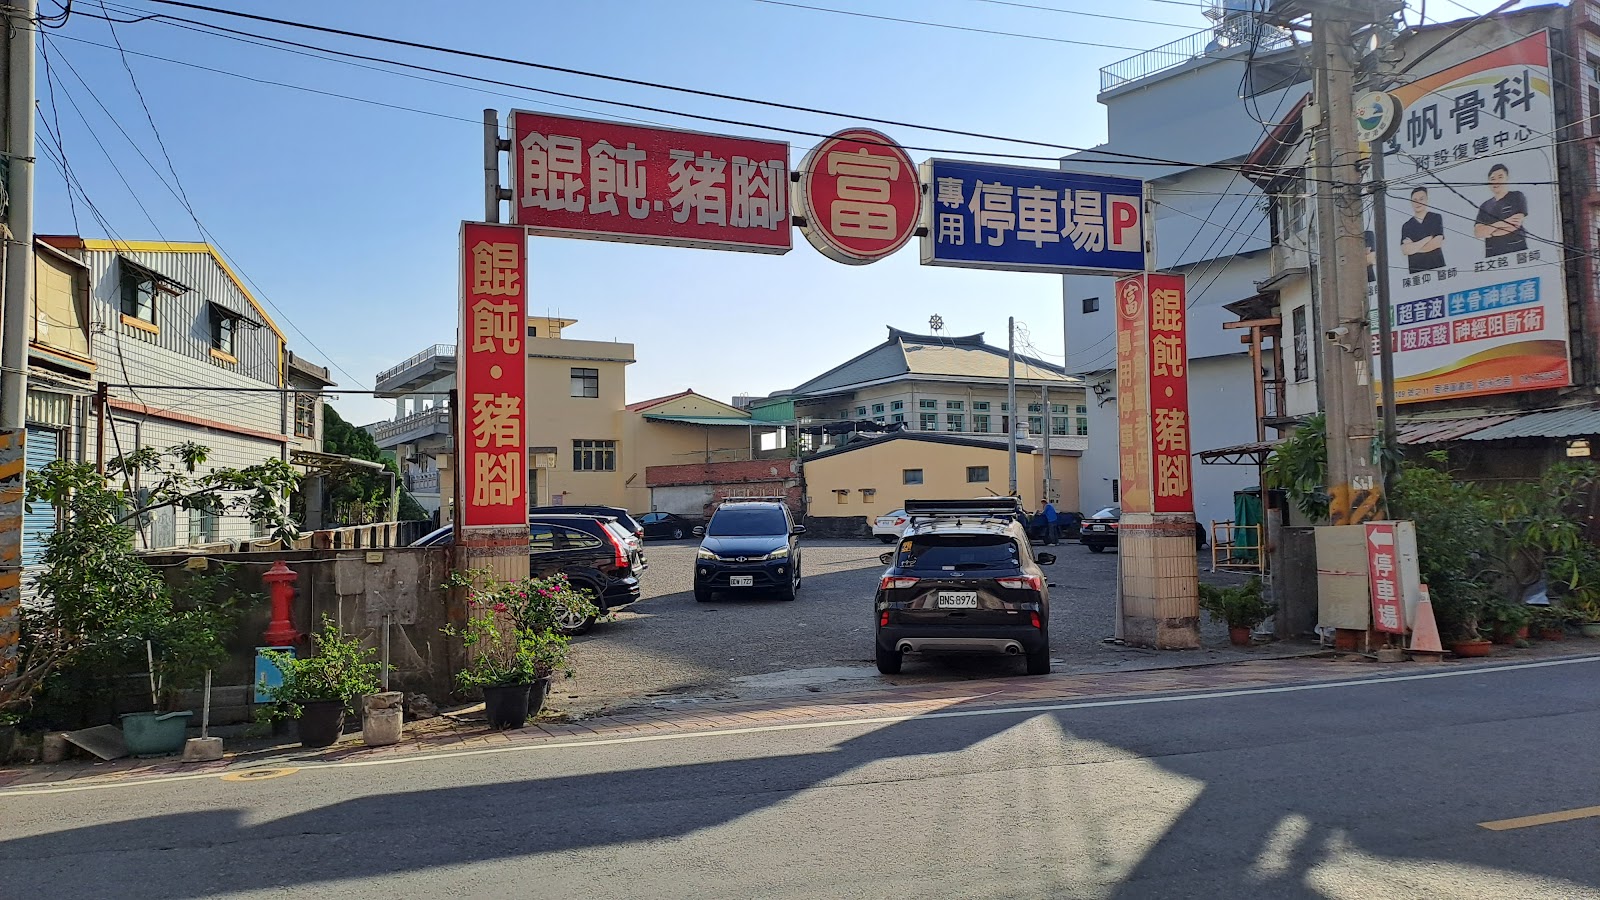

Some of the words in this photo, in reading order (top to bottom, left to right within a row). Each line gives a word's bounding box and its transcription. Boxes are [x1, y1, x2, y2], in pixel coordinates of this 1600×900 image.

[1416, 124, 1533, 172] 附設復健中心
[827, 147, 900, 241] 富
[937, 176, 965, 246] 專用
[967, 179, 1105, 254] 停車場
[1111, 200, 1139, 246] P
[1122, 284, 1139, 316] 富
[1398, 298, 1443, 326] 超音波
[1450, 279, 1537, 315] 坐骨神經痛
[1403, 327, 1448, 351] 玻尿酸
[1455, 308, 1542, 342] 神經阻斷術
[1118, 329, 1136, 482] 專用停車場
[1373, 552, 1398, 629] 停車場
